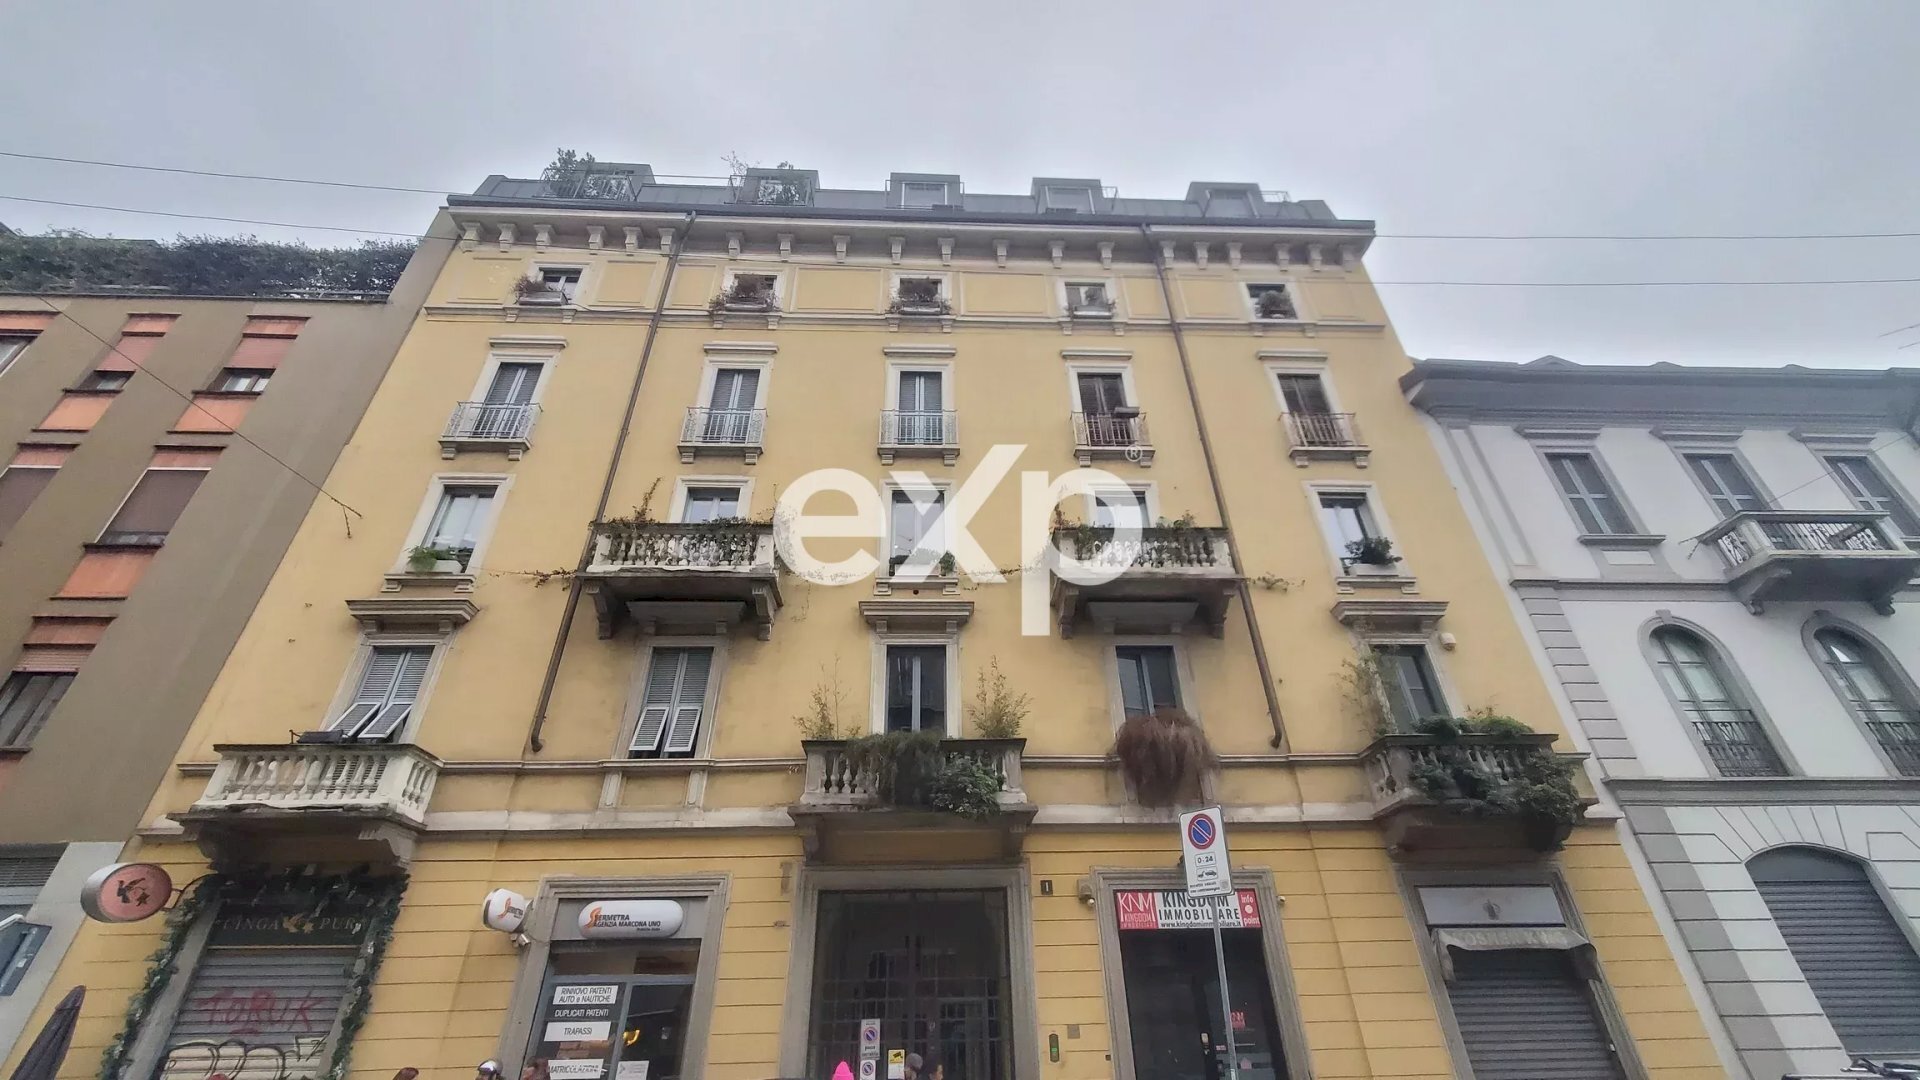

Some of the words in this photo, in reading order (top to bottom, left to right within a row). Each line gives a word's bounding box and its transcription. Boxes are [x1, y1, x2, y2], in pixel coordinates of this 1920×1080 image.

[1162, 892, 1230, 908] KINGDM
[1241, 895, 1254, 903] info
[1158, 908, 1240, 921] IMMOBILARE
[1243, 916, 1261, 926] point
[560, 987, 588, 995] RINNOVO
[589, 987, 612, 995] PATENTI
[558, 995, 576, 1003] AUTO
[554, 1009, 585, 1017] DUPLICATI
